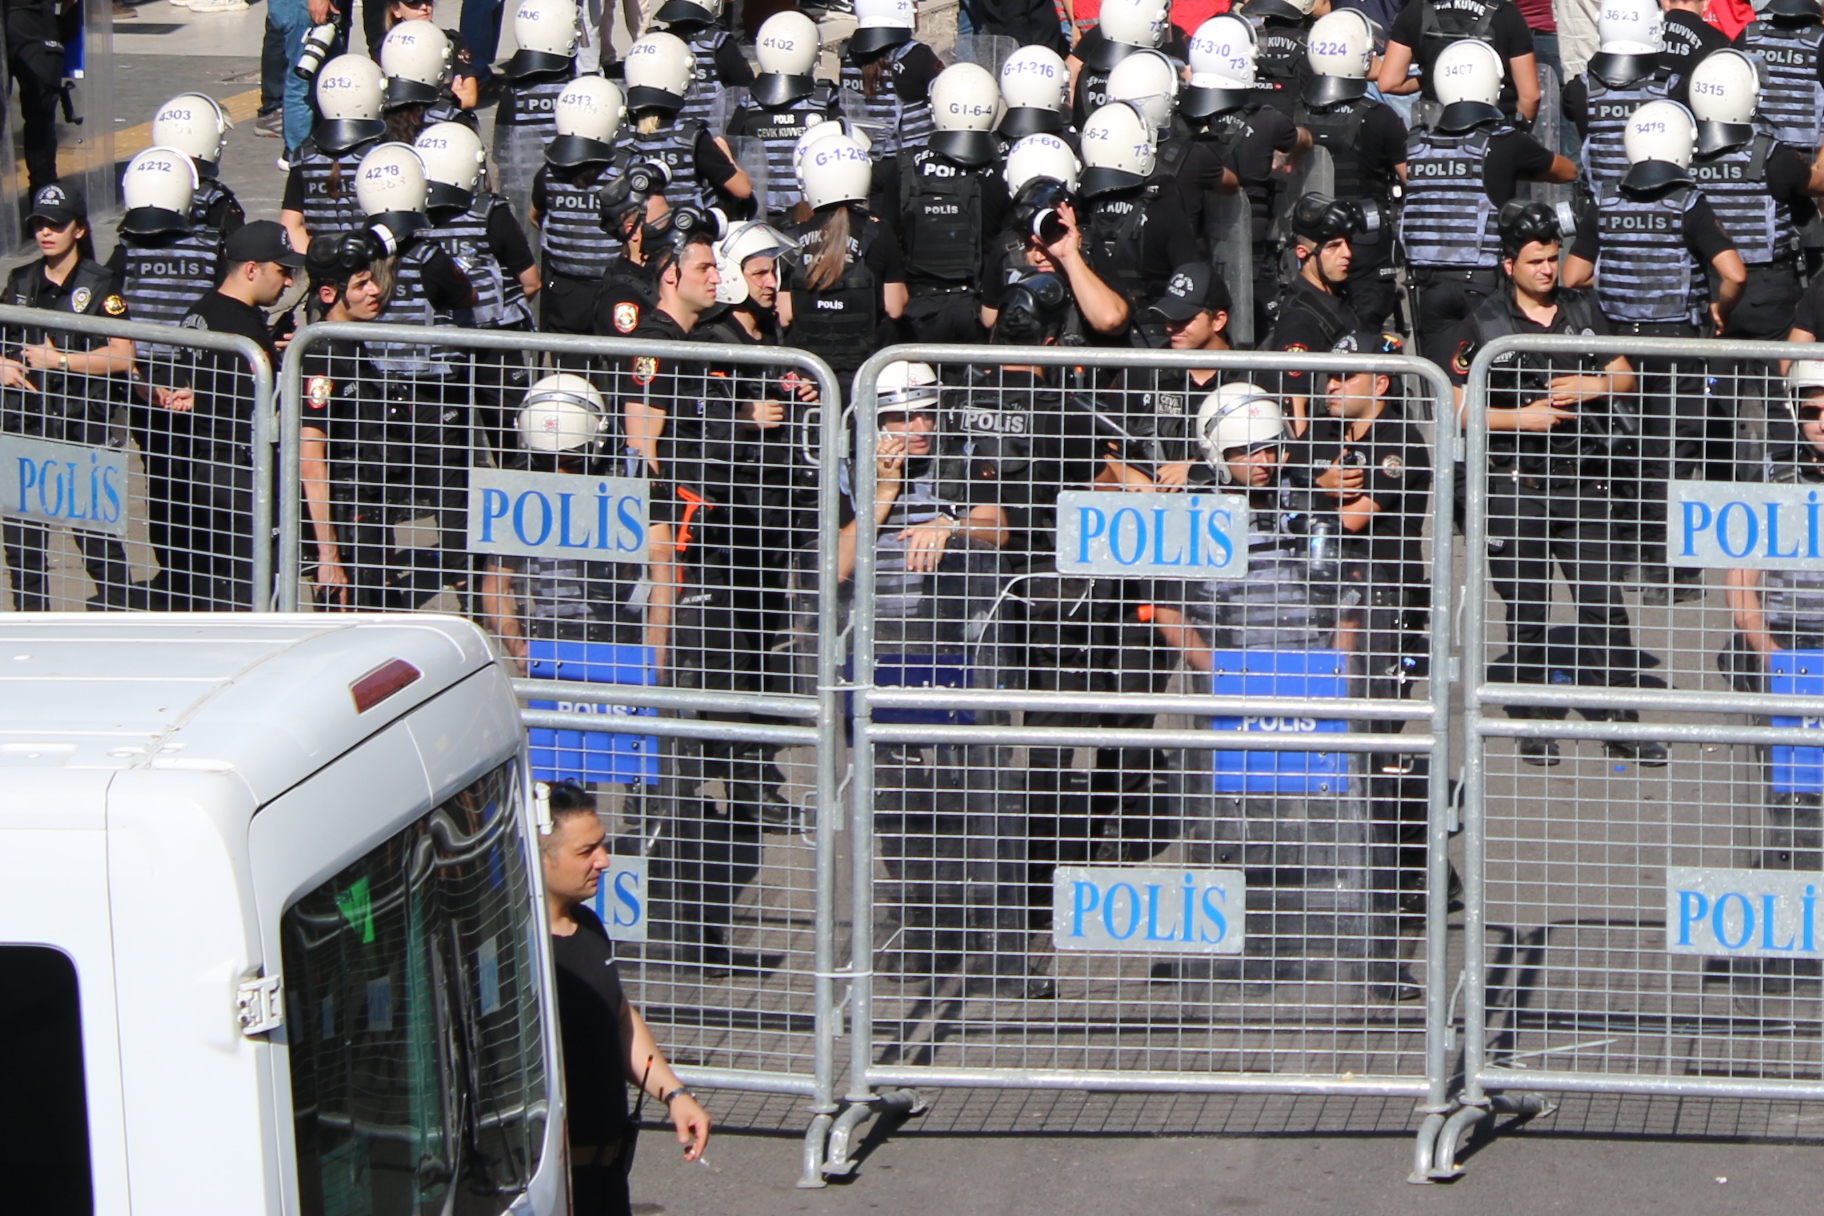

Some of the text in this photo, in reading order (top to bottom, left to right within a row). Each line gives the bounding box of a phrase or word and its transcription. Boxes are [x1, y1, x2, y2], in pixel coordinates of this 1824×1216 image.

[1668, 23, 1703, 50] KUVVET
[627, 43, 657, 57] 4216
[762, 36, 794, 53] 4102
[1756, 48, 1805, 65] POLİS
[1229, 57, 1246, 72] 73
[321, 76, 352, 91] 4319
[1694, 81, 1725, 97] 3315
[561, 93, 592, 107] 4313
[159, 110, 191, 122] 4303
[416, 137, 448, 151] 4213
[1133, 143, 1151, 158] 73
[137, 159, 172, 173] 4212
[364, 165, 400, 180] 4218
[1413, 160, 1468, 178] POLİS
[1689, 163, 1743, 180] POLİS
[924, 204, 959, 216] POLİS
[1610, 213, 1668, 231] POLİS
[140, 261, 200, 276] POLİS
[816, 299, 845, 310] POLİS
[964, 408, 1026, 434] POLİS
[18, 455, 122, 524] POLİS
[480, 482, 644, 552] POLİS
[1079, 495, 1233, 568] POLİS
[1070, 873, 1228, 944] POLİS
